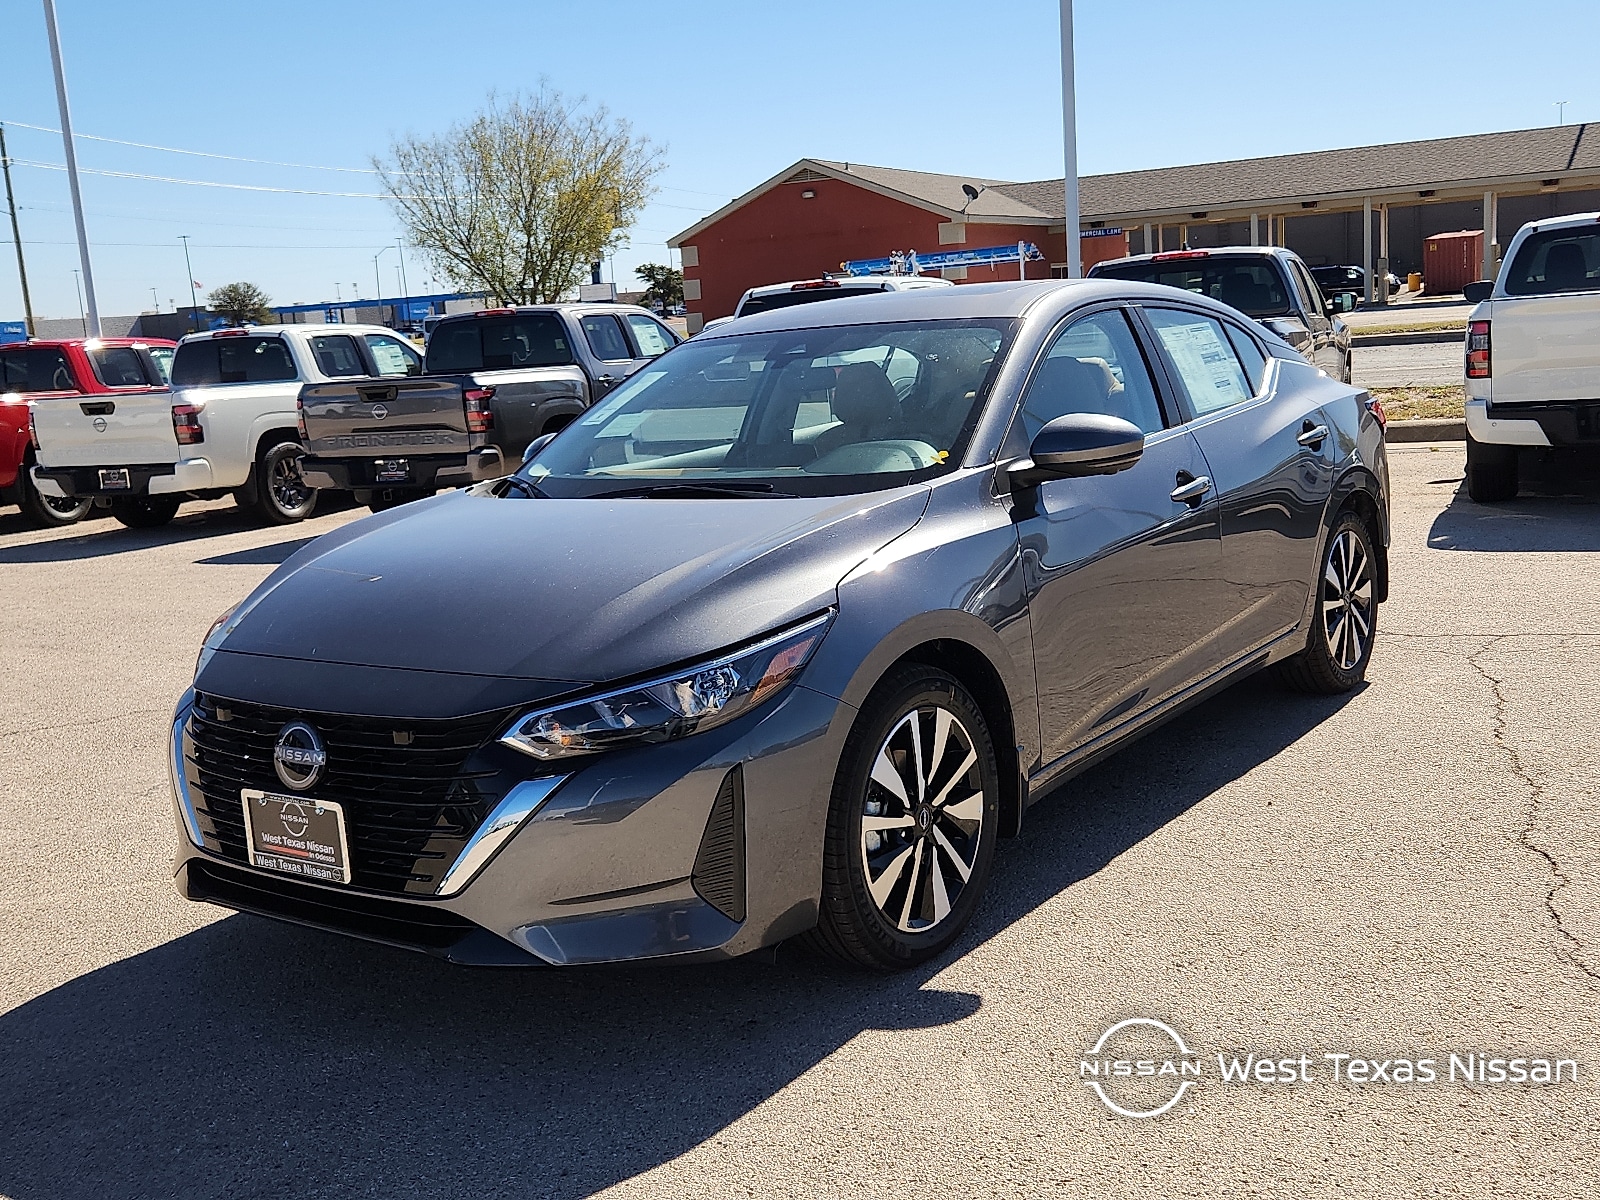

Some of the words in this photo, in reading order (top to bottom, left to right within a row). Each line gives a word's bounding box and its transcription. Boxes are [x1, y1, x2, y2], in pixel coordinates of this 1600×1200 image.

[1080, 229, 1105, 237] MERCIAL
[322, 433, 455, 448] FRONTIER
[274, 745, 323, 763] NISSAN
[280, 813, 309, 824] NISSAN
[261, 832, 281, 845] West
[282, 837, 306, 849] Texas
[306, 841, 335, 855] Nissan
[315, 853, 336, 863] Odessa
[256, 855, 279, 866] West
[279, 859, 302, 873] Texas
[303, 864, 332, 879] Nissan
